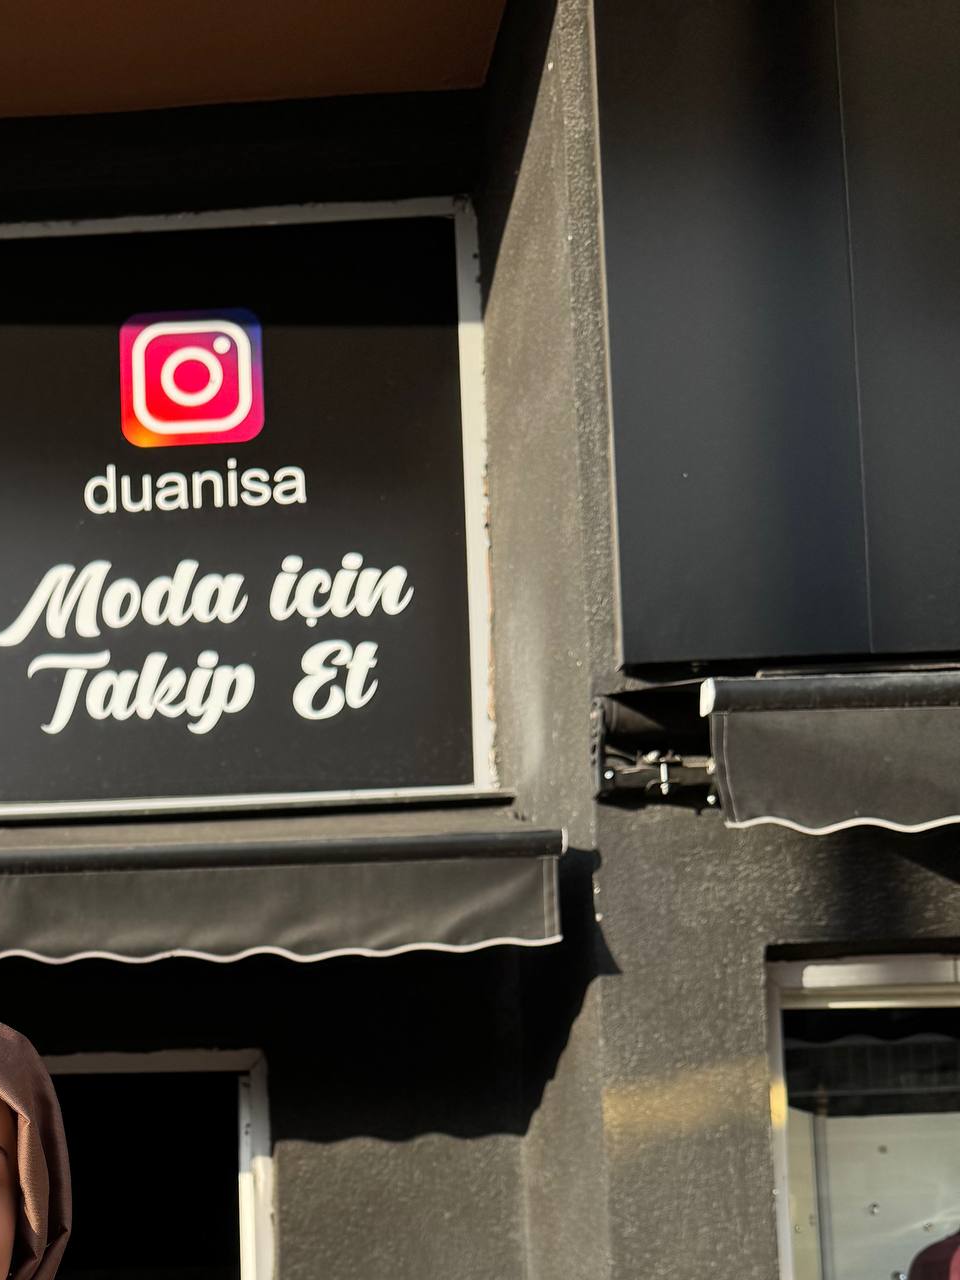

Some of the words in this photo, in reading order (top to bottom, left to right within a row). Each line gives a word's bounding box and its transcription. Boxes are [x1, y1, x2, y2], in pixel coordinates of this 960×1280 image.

[83, 458, 307, 515] duanisa
[269, 552, 415, 628] için
[27, 649, 256, 735] Takip
[292, 639, 379, 721] Et
